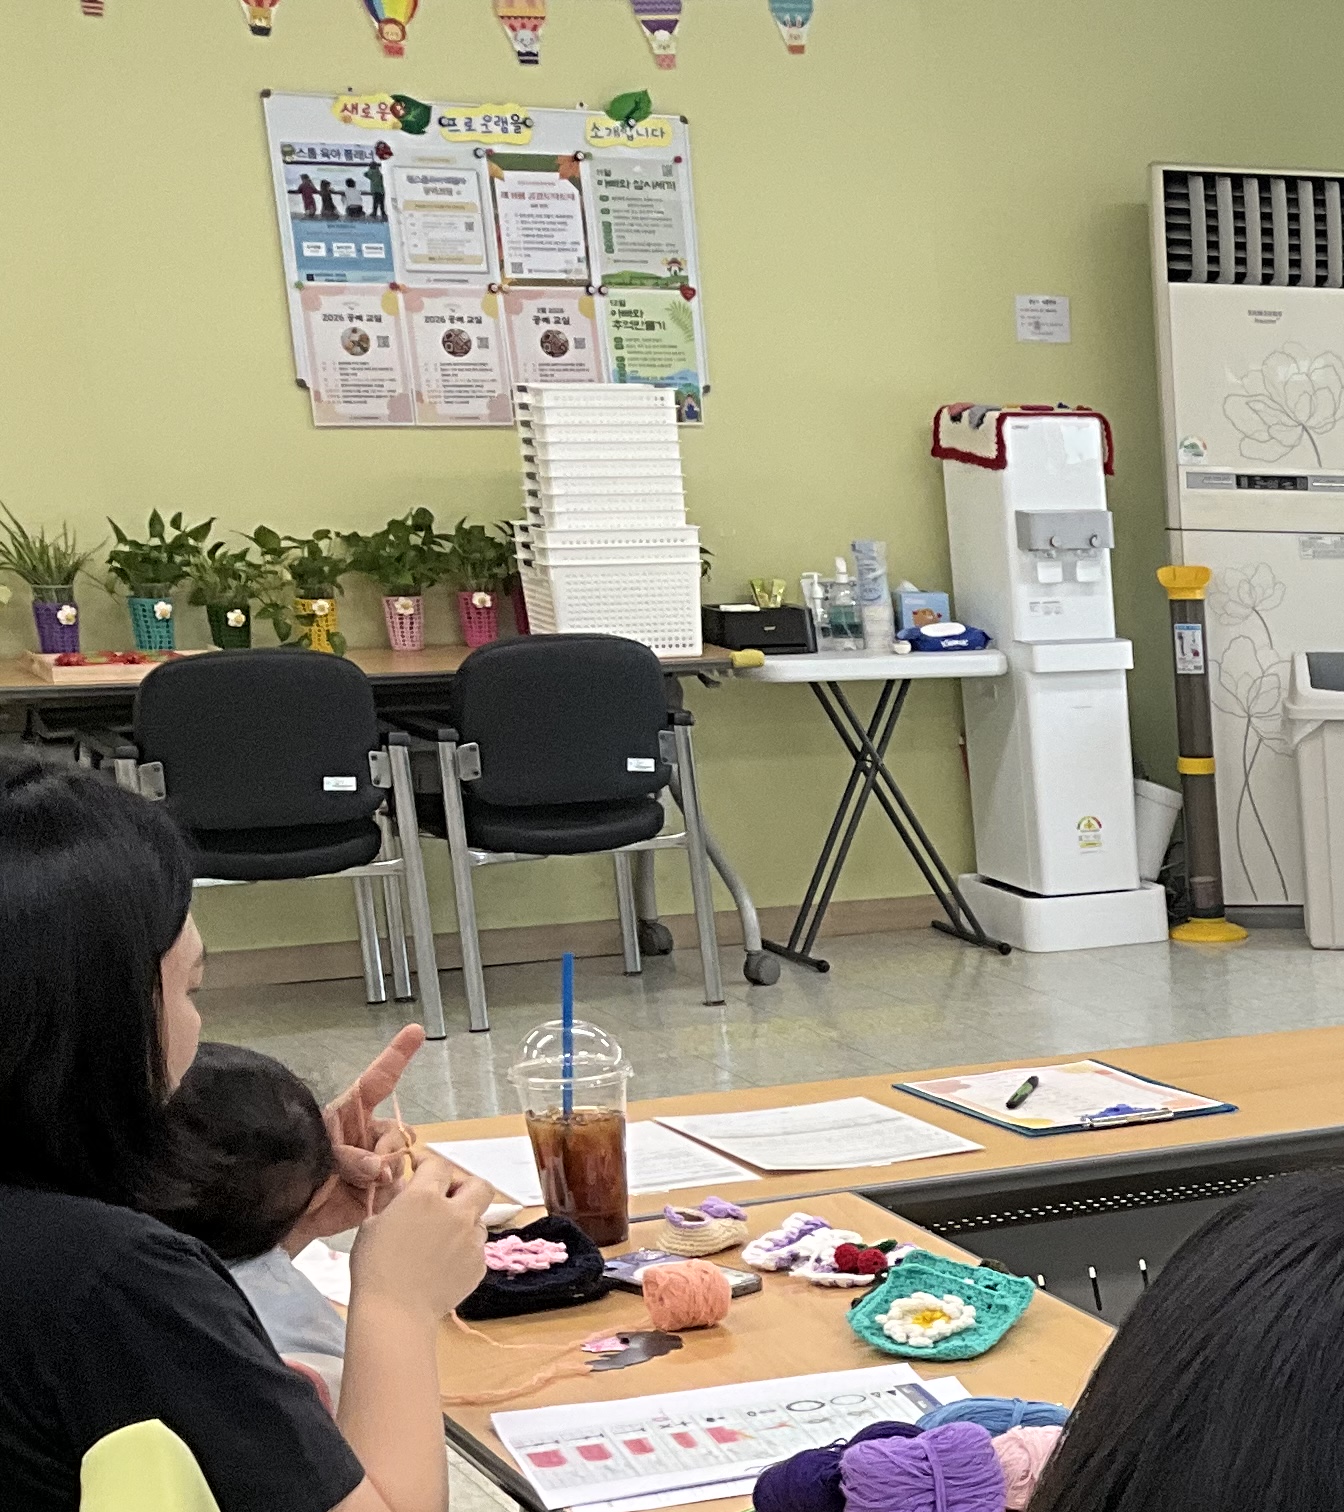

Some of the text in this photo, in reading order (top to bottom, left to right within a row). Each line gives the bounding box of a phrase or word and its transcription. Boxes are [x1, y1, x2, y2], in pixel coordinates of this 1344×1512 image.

[340, 102, 391, 122] 새로운
[589, 122, 666, 142] 소개합니다
[322, 313, 345, 323] 2026
[424, 315, 447, 324] 2026
